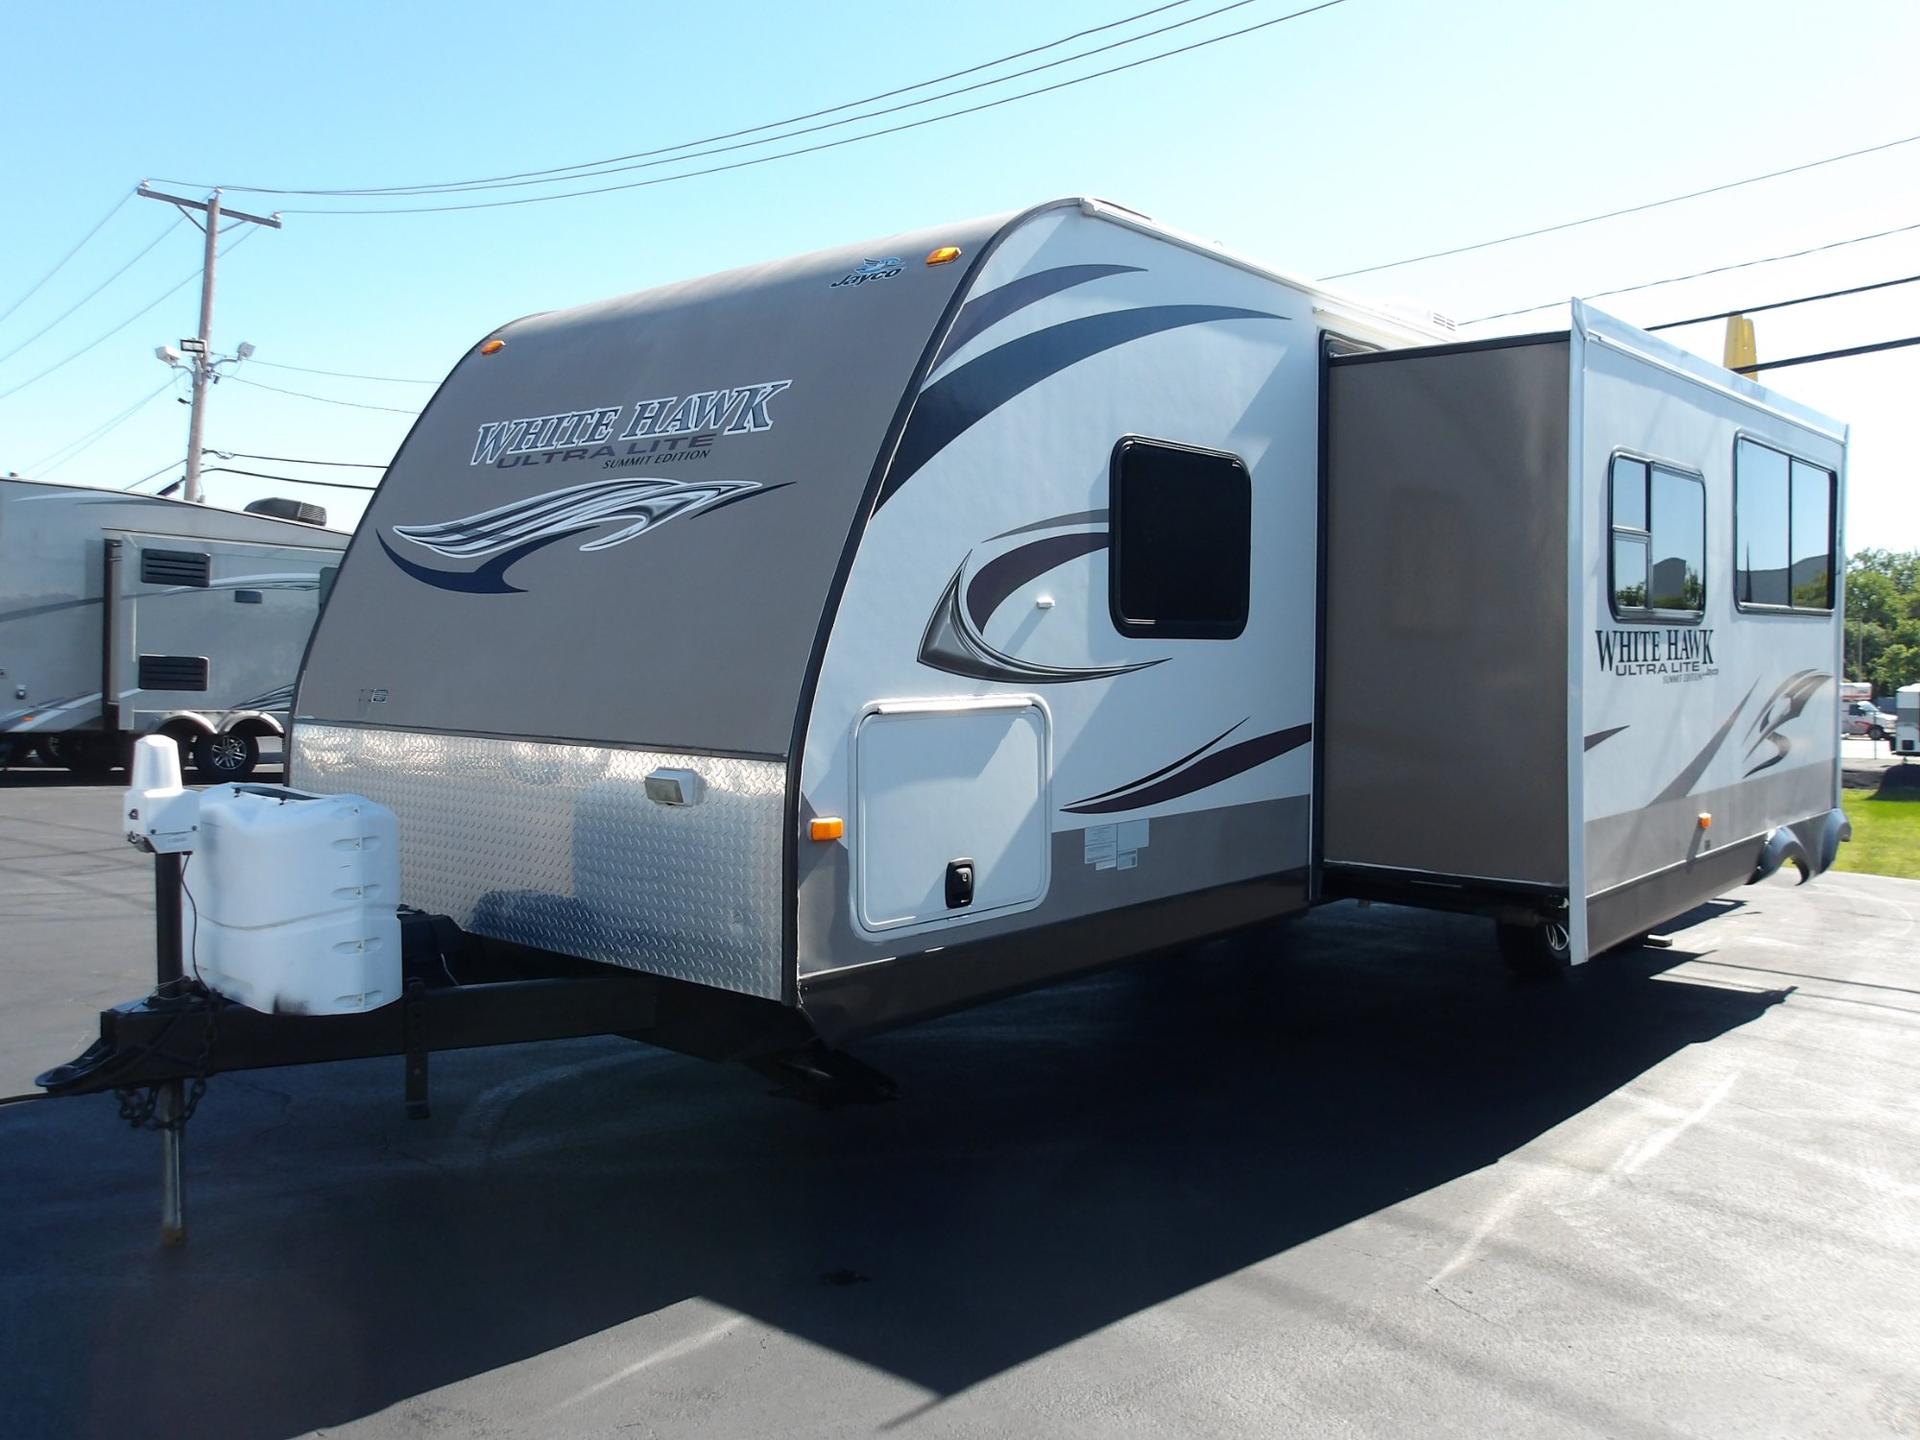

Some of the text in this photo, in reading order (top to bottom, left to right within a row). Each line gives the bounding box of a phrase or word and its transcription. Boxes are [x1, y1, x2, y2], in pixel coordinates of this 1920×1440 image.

[829, 267, 905, 288] Jayco
[470, 379, 793, 466] WHITE HAWK
[496, 433, 718, 469] ULTRA LITE
[602, 448, 711, 469] SUMMIT EDITION
[1595, 629, 1714, 672] WHITE HAWK
[1615, 662, 1668, 676] ULTRA
[1671, 660, 1700, 673] LITE
